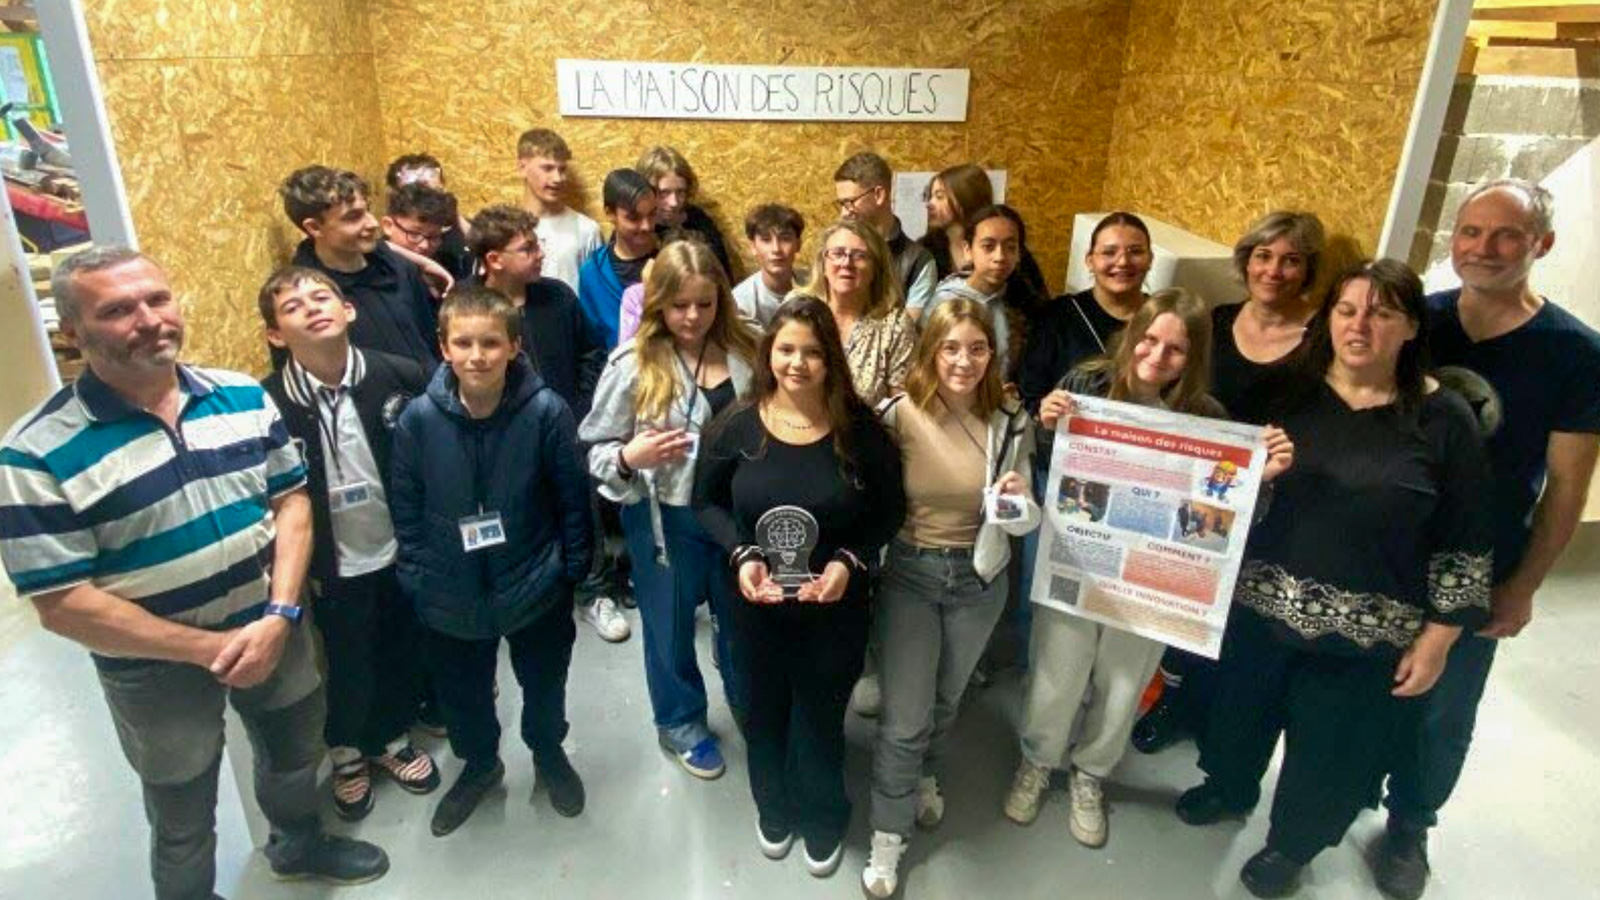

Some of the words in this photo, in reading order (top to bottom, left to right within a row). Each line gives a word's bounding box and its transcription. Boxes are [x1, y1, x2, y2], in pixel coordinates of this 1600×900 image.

[575, 69, 614, 111] LA
[750, 73, 799, 114] DES
[1068, 442, 1118, 457] CONSTAT
[1094, 425, 1108, 436] La
[1110, 429, 1153, 445] maison
[1155, 437, 1177, 450] des
[1179, 441, 1224, 458] risques
[1131, 486, 1152, 498] QUI
[1154, 490, 1161, 500] ?
[1066, 524, 1112, 541] OBJECTIF
[1146, 541, 1202, 562] COMMENT
[1135, 588, 1200, 616] INNOVATION
